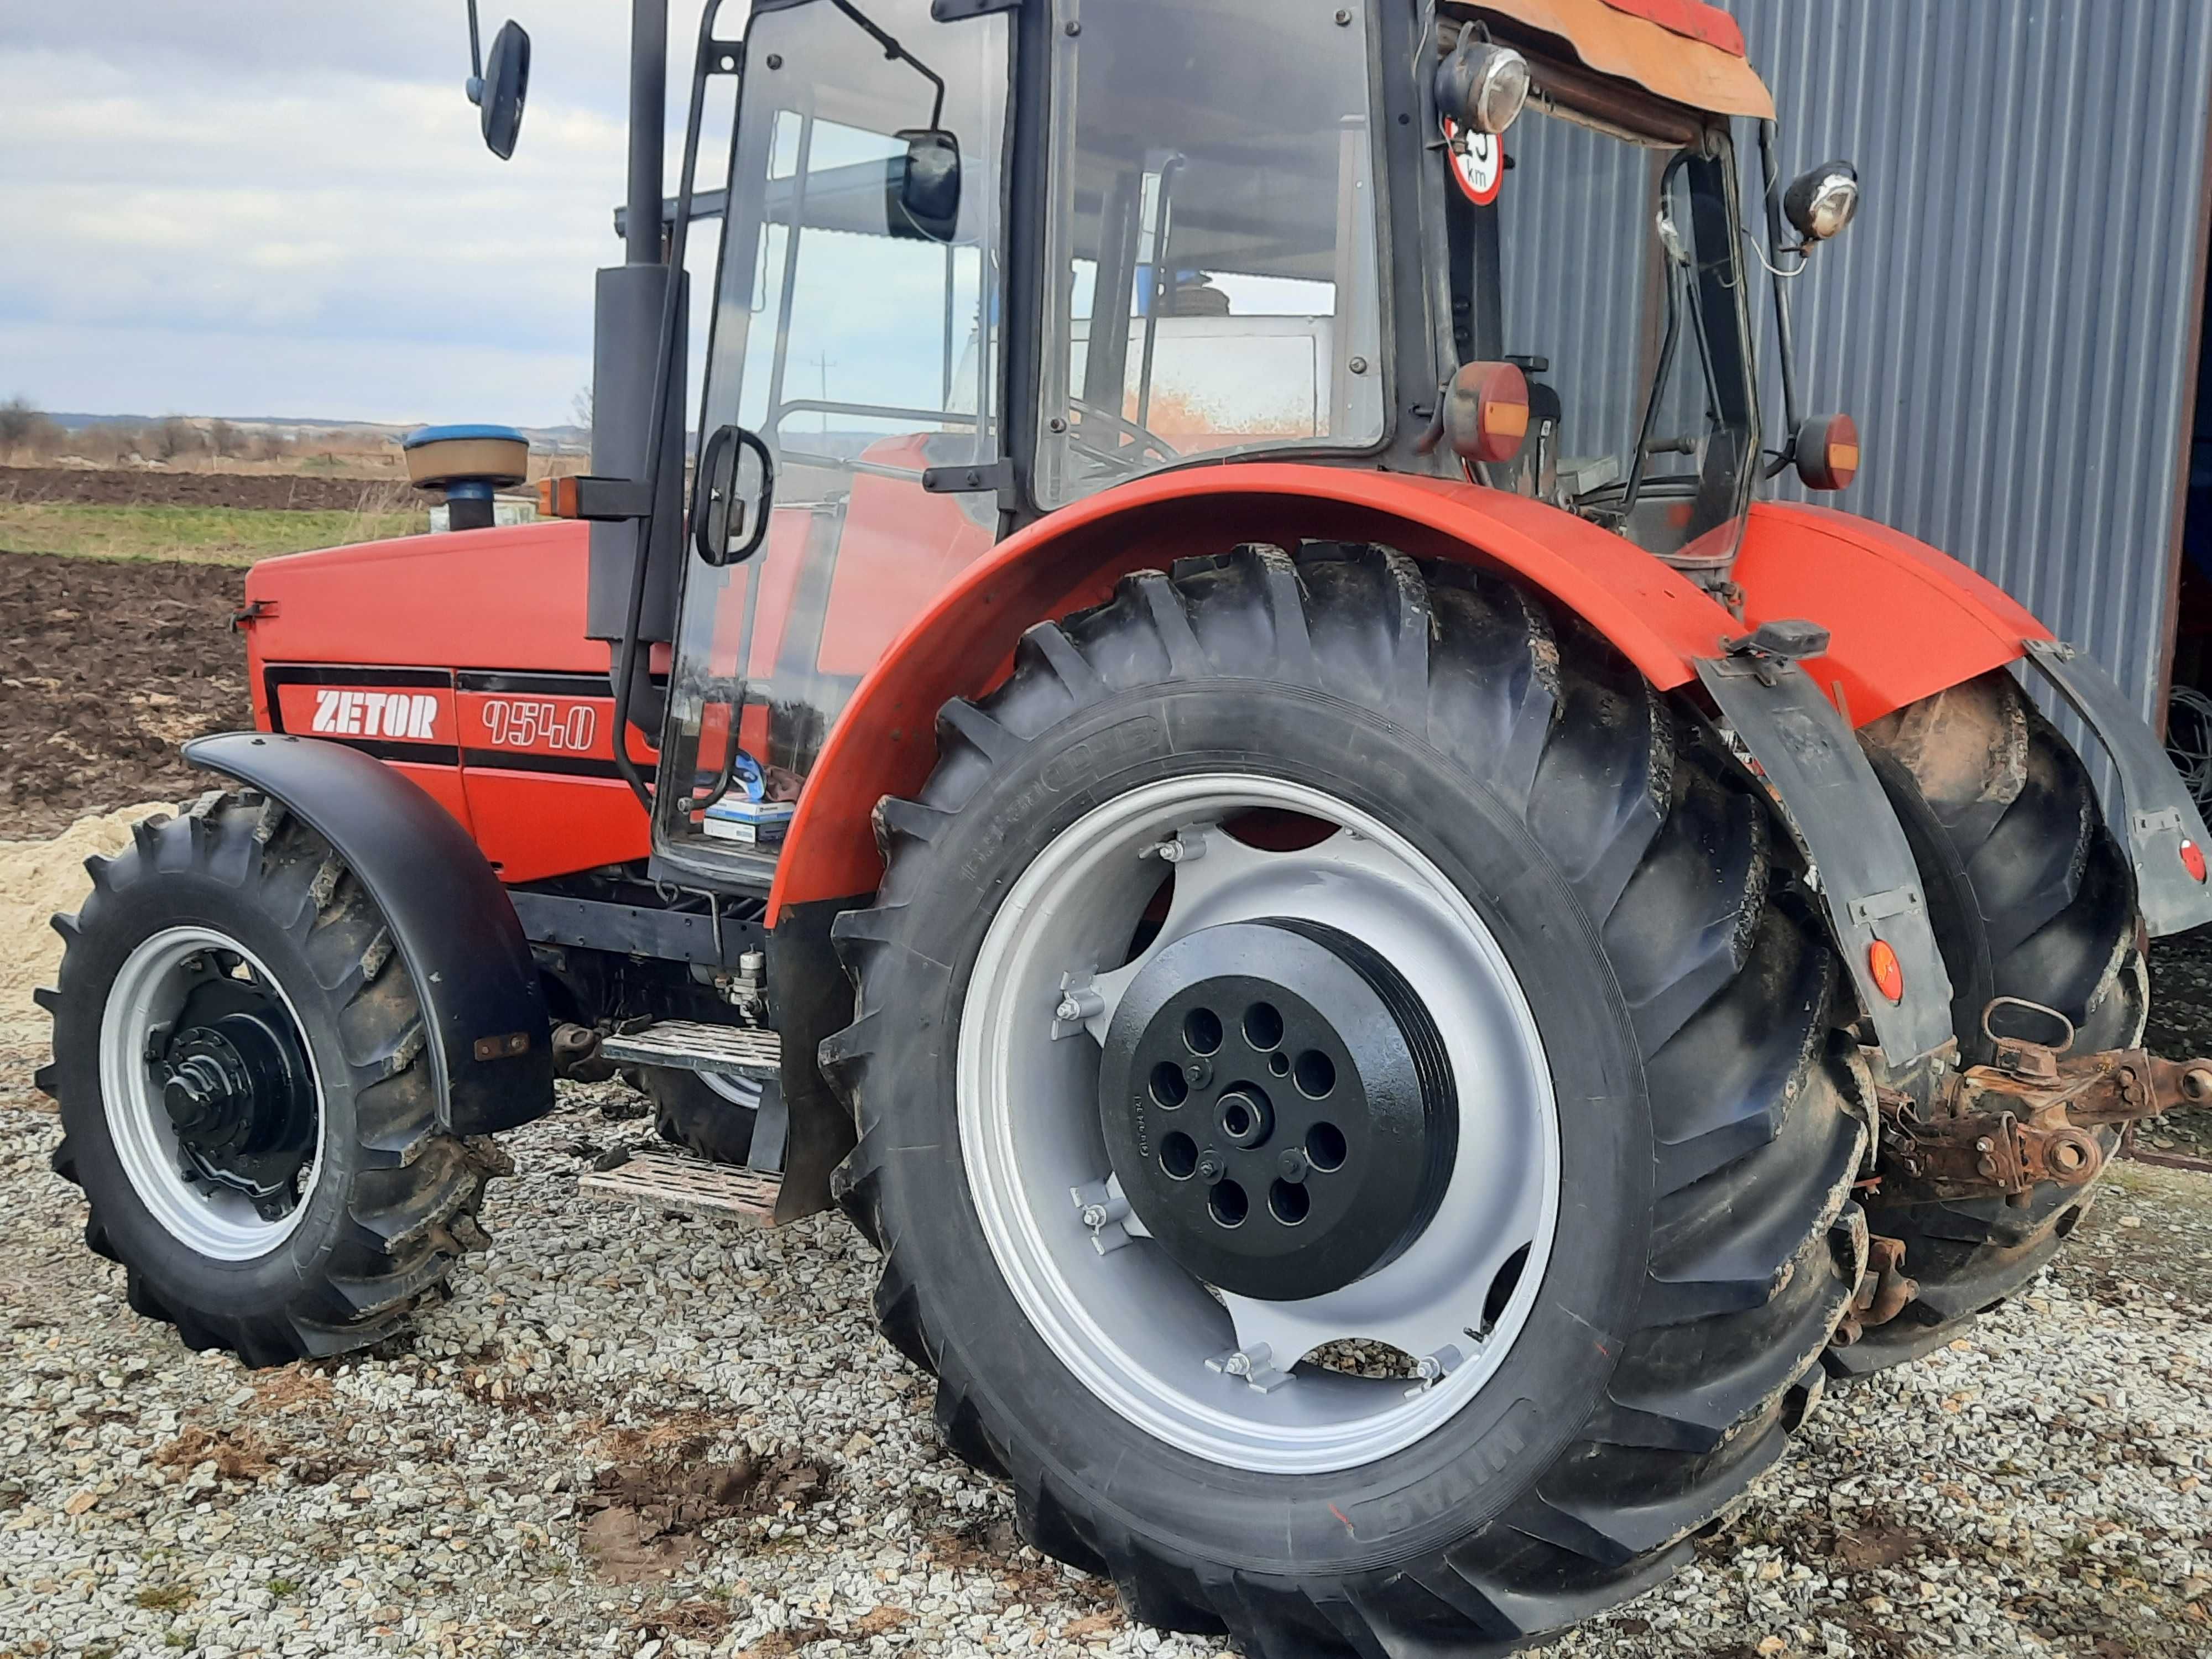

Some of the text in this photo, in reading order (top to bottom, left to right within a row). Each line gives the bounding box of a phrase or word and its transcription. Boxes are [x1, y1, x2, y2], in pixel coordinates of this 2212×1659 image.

[1467, 159, 1486, 187] km
[312, 690, 596, 750] ZETOR 9540
